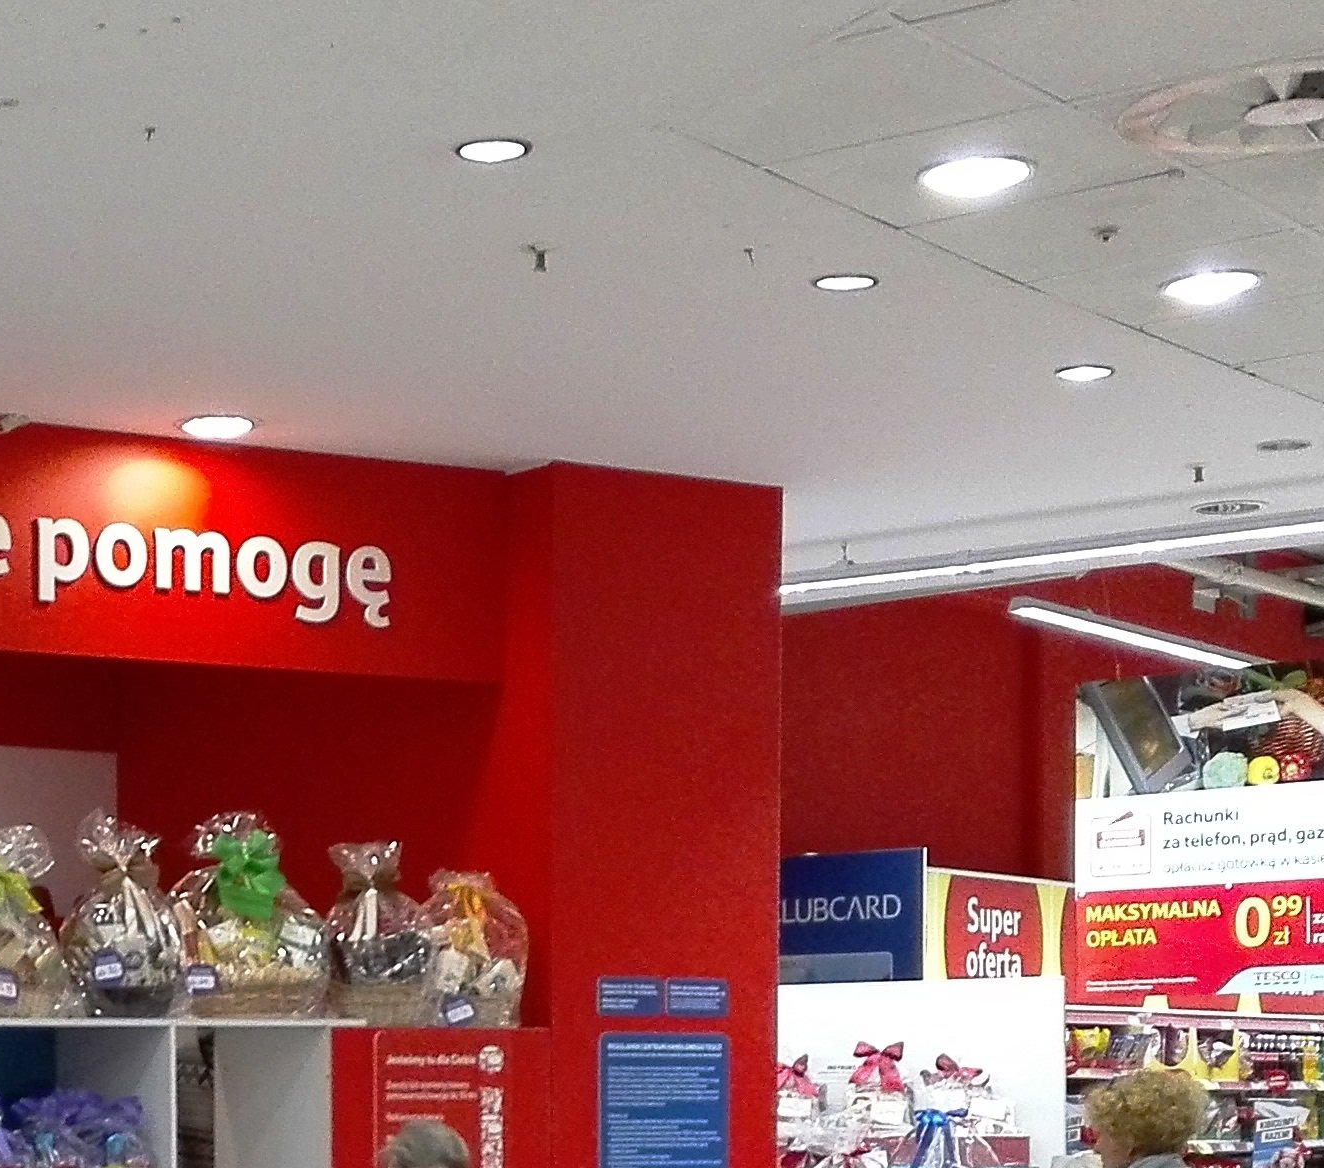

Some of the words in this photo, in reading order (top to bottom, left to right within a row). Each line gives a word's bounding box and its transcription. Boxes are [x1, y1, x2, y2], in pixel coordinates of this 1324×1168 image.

[36, 515, 394, 629] pomogę
[1163, 807, 1240, 826] Rachunki
[1163, 838, 1181, 850] za
[1184, 831, 1247, 848] telefon,
[1250, 827, 1292, 847] prąd,
[779, 894, 902, 925] LUBCARD
[966, 896, 1022, 942] Super
[1085, 899, 1222, 924] MAKSYMALNA
[1085, 928, 1158, 949] OPŁATA
[1272, 925, 1291, 945] zł
[965, 942, 1022, 978] oferta
[1253, 970, 1301, 981] TESCO
